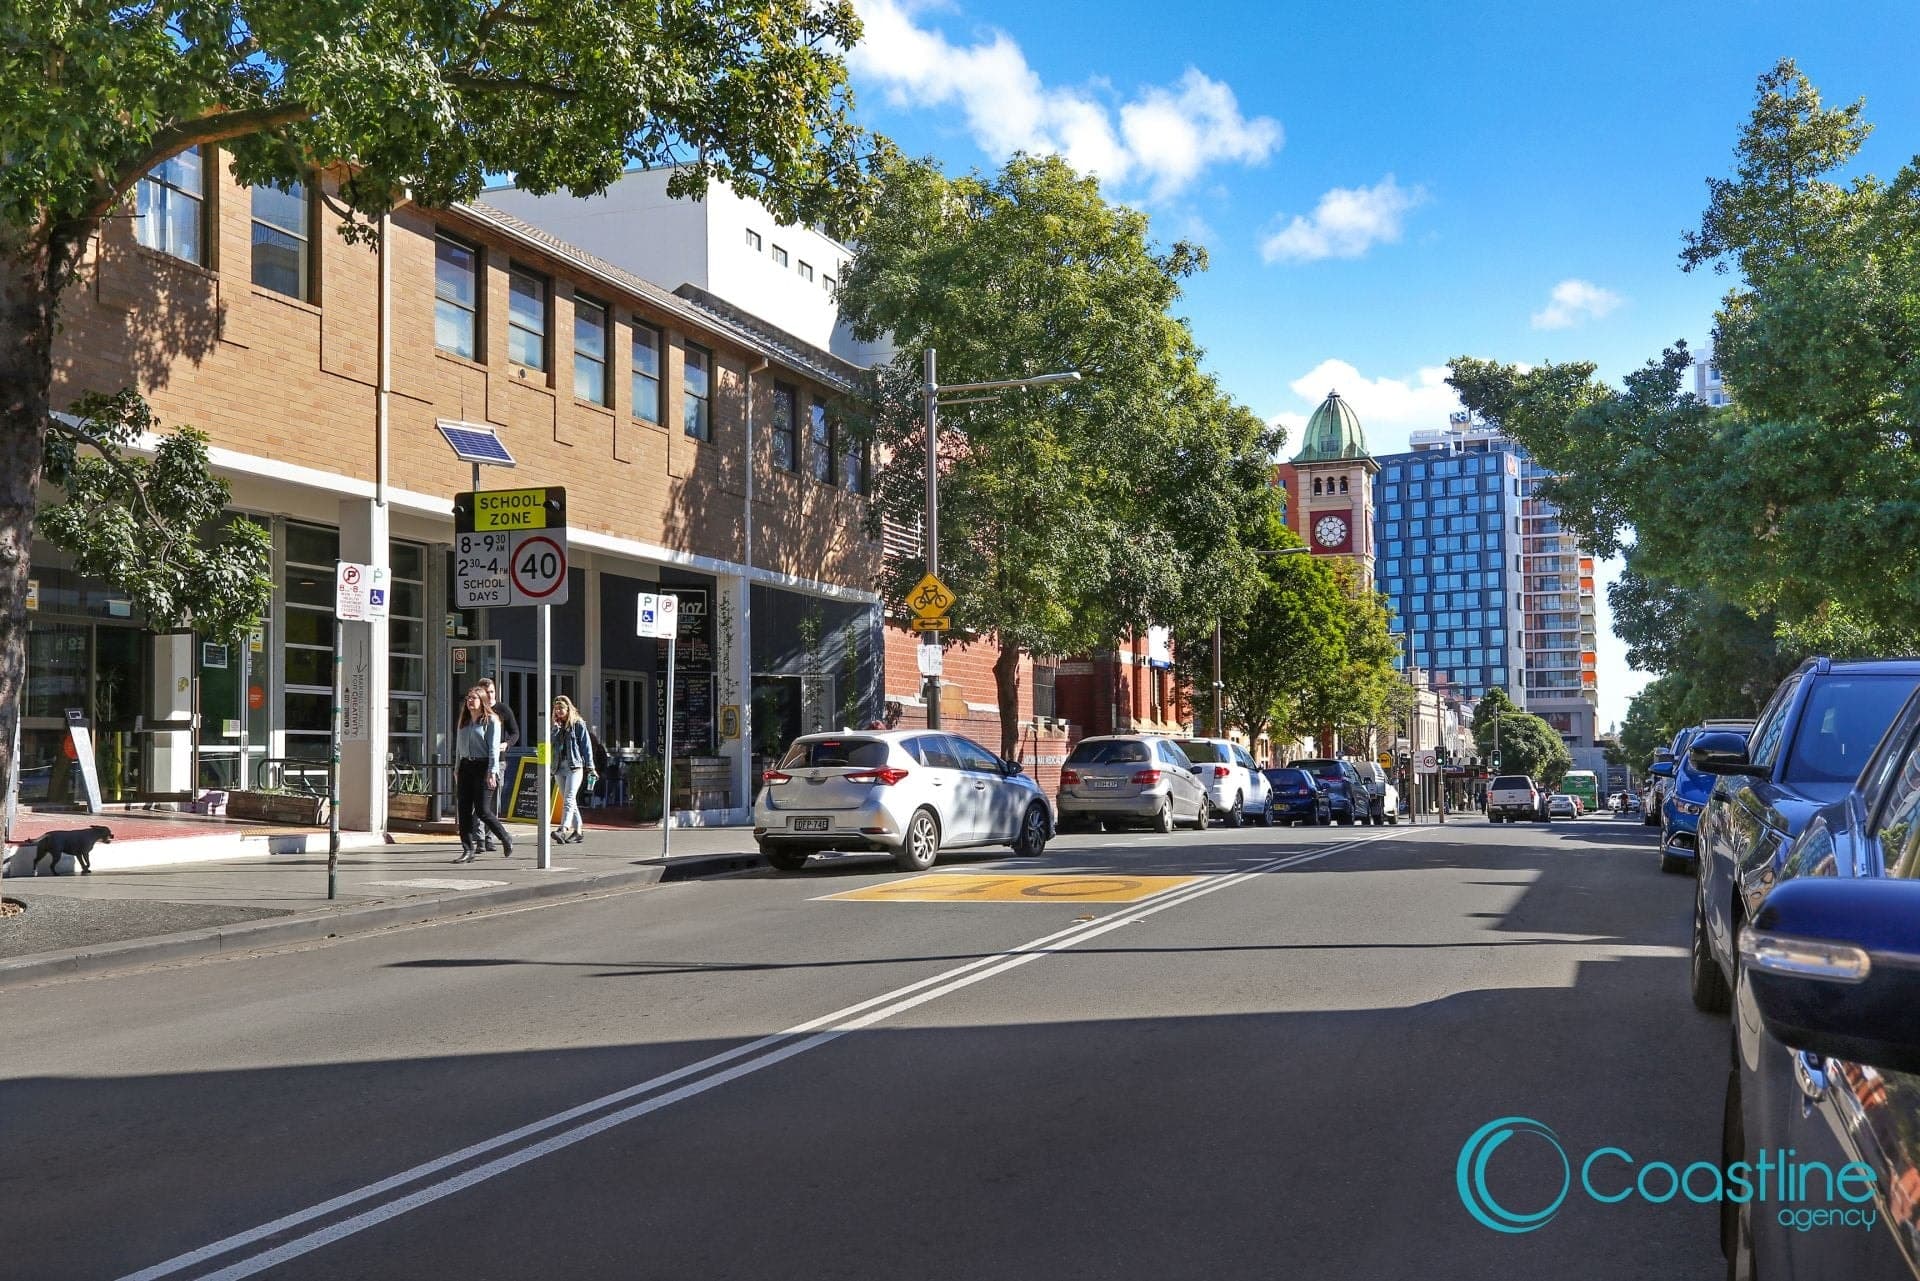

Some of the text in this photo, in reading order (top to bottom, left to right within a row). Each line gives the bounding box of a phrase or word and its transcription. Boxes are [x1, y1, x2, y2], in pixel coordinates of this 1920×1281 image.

[480, 495, 541, 510] SCHOOL
[490, 511, 531, 526] ZONE
[520, 552, 557, 580] 40
[463, 578, 505, 590] SCHOOL
[469, 591, 499, 602] DAYS
[657, 680, 665, 754] UPCOMING
[876, 879, 1143, 897] 40
